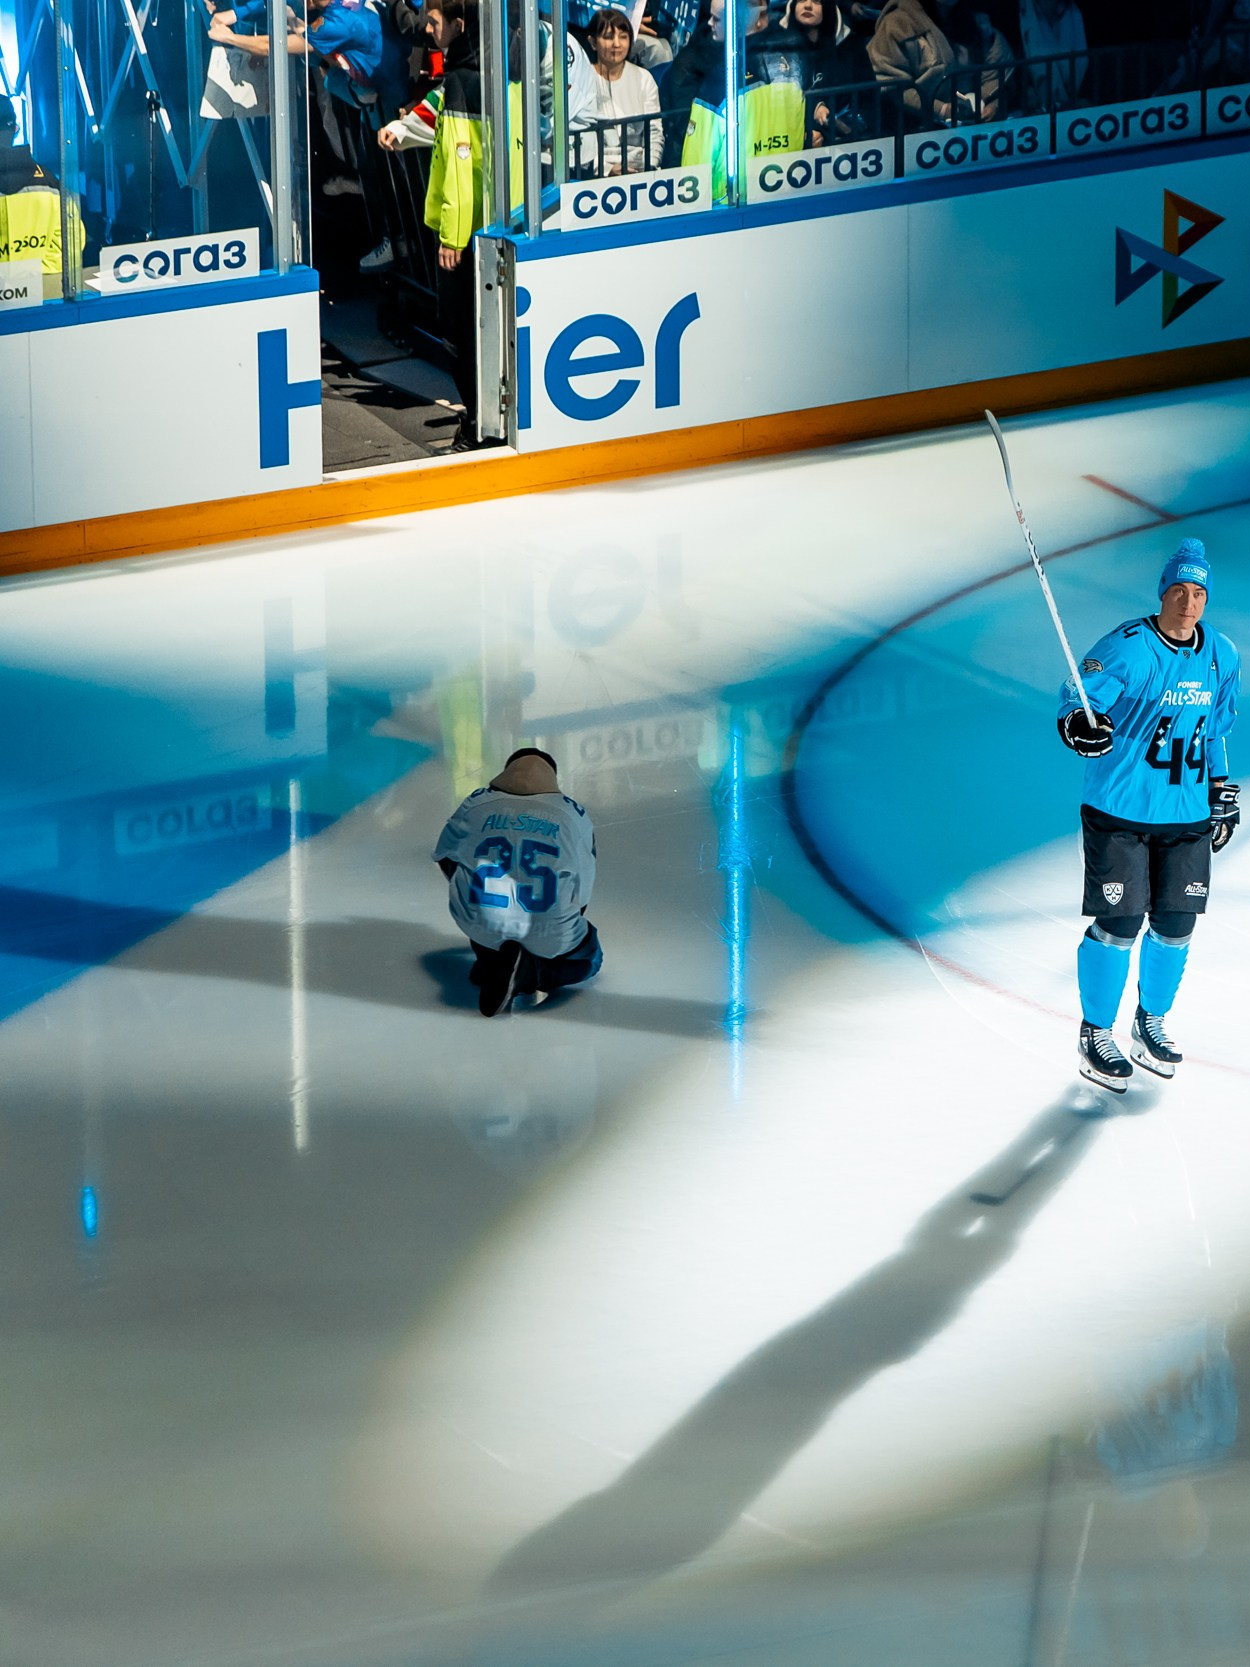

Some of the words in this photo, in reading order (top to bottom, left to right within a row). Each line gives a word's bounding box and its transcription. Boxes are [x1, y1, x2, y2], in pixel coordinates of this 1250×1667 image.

[1066, 102, 1190, 146] согаз
[915, 125, 1039, 170] согаз
[758, 148, 884, 193] согаз
[572, 174, 700, 219] согаз
[112, 240, 248, 284] согаз
[1144, 715, 1208, 785] 44
[469, 835, 561, 914] 25
